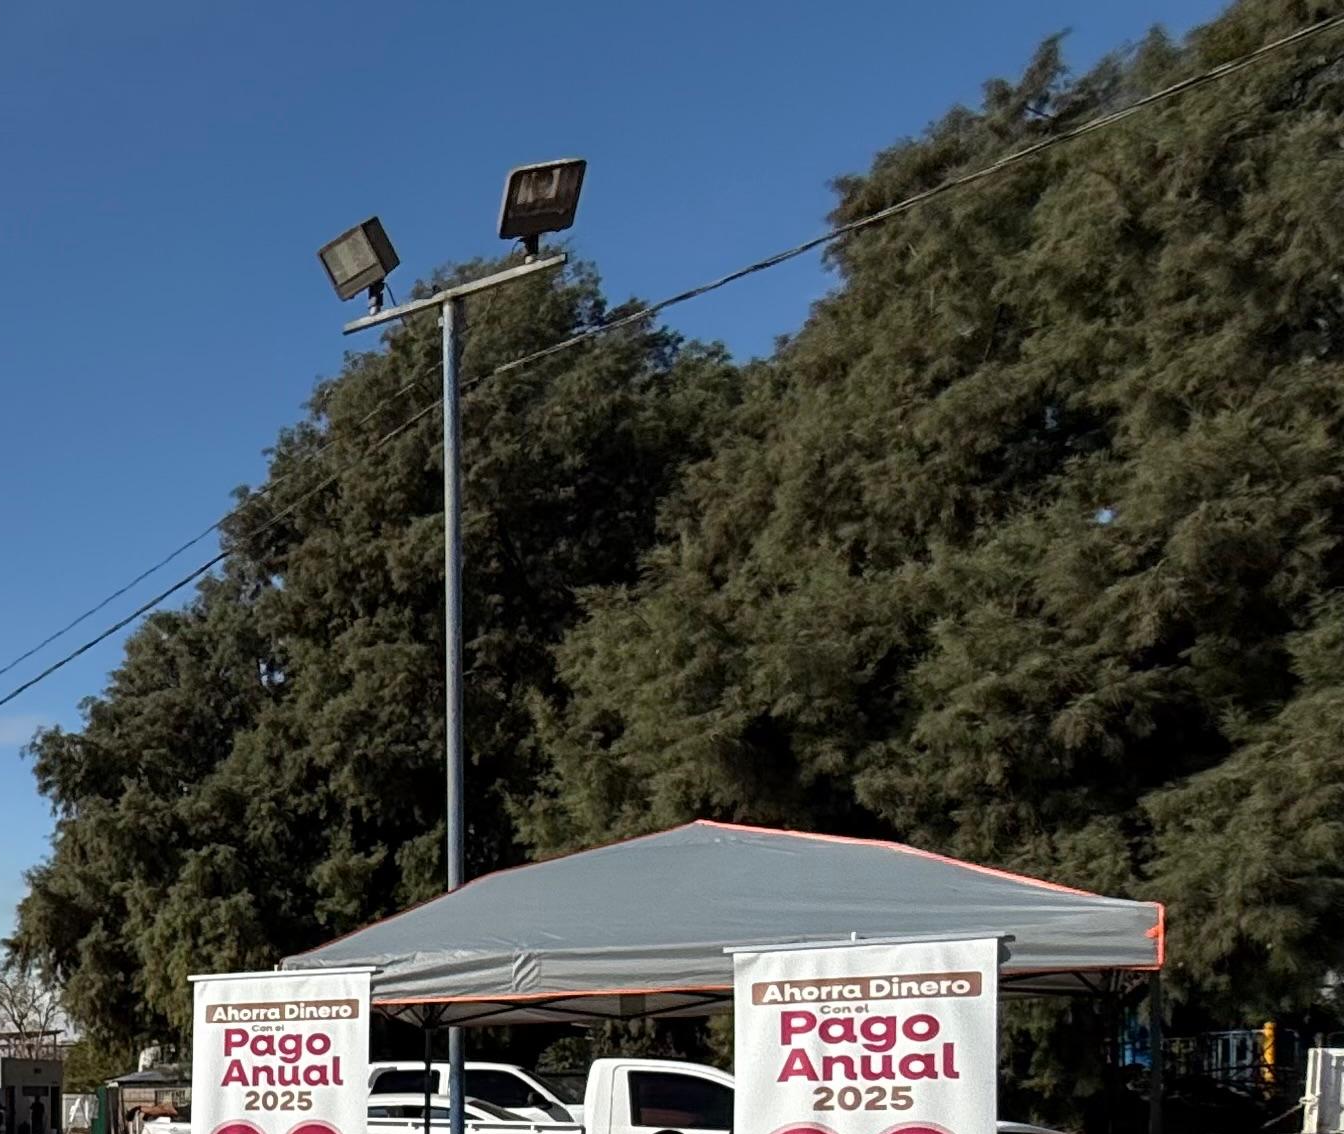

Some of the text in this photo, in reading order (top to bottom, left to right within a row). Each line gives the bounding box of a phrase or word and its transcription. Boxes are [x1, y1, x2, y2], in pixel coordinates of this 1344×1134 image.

[763, 977, 971, 1003] Ahorra Dinero
[212, 1003, 352, 1021] Ahorra Dinero
[820, 1004, 869, 1014] Con el
[275, 1024, 285, 1032] el
[780, 1010, 940, 1053] Pago
[224, 1028, 331, 1063] Pago
[221, 1056, 343, 1086] Anual
[777, 1043, 960, 1082] Anual
[245, 1090, 313, 1111] 2025
[812, 1086, 914, 1111] 2025
